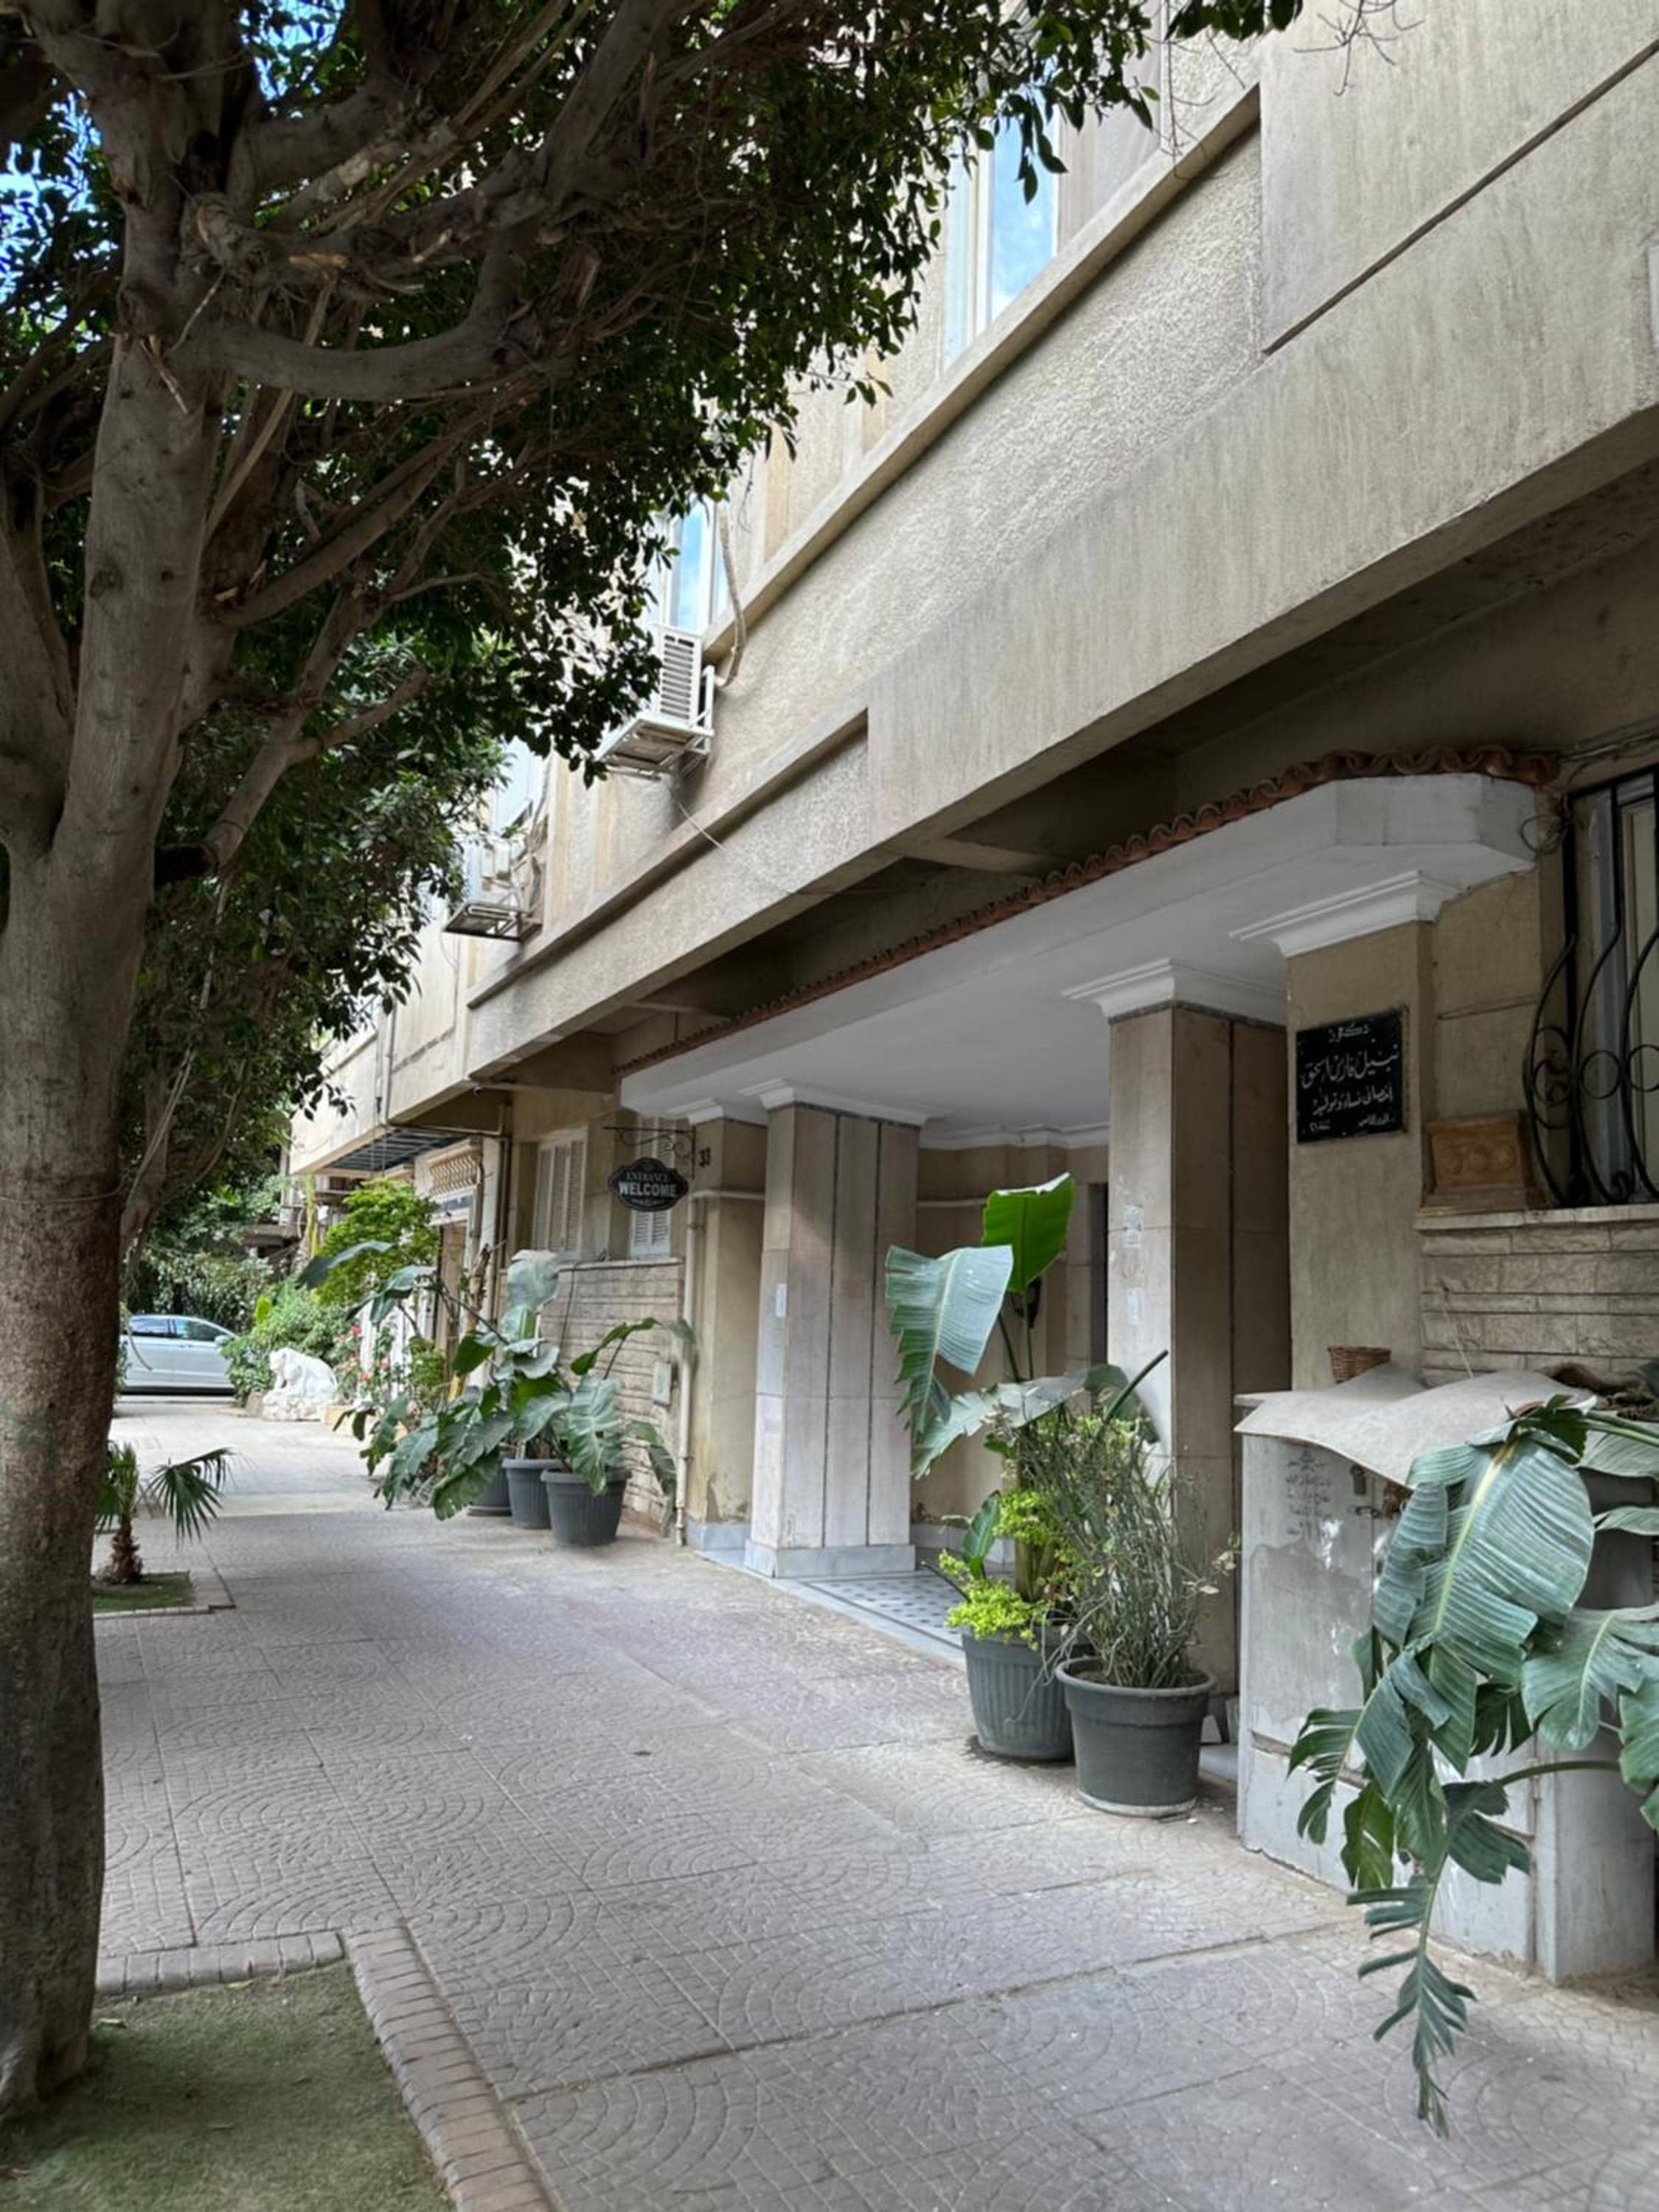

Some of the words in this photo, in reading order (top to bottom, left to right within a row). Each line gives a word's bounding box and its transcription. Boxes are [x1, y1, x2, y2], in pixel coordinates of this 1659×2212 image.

[1328, 1023, 1369, 1043] دكتور
[1354, 1044, 1399, 1079] نبيل
[619, 1180, 678, 1197] WELCOME
